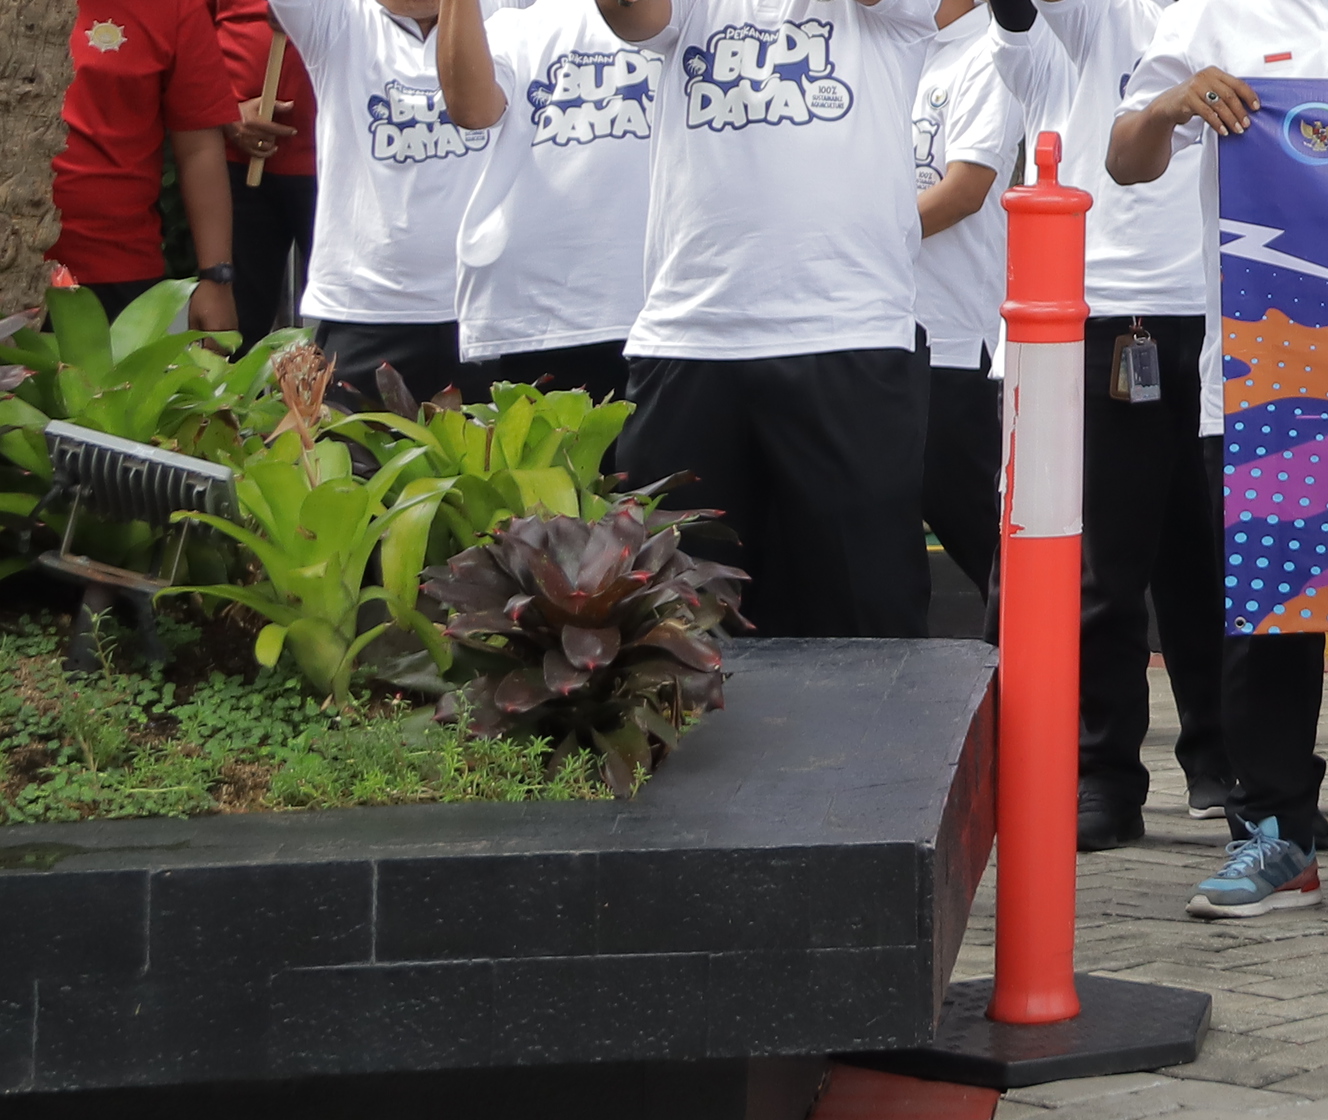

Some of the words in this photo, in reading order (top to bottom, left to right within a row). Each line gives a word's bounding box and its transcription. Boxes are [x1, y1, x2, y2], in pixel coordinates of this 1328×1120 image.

[531, 100, 650, 147] DAYA
[687, 78, 810, 129] DAYA
[374, 122, 468, 162] DAYA
